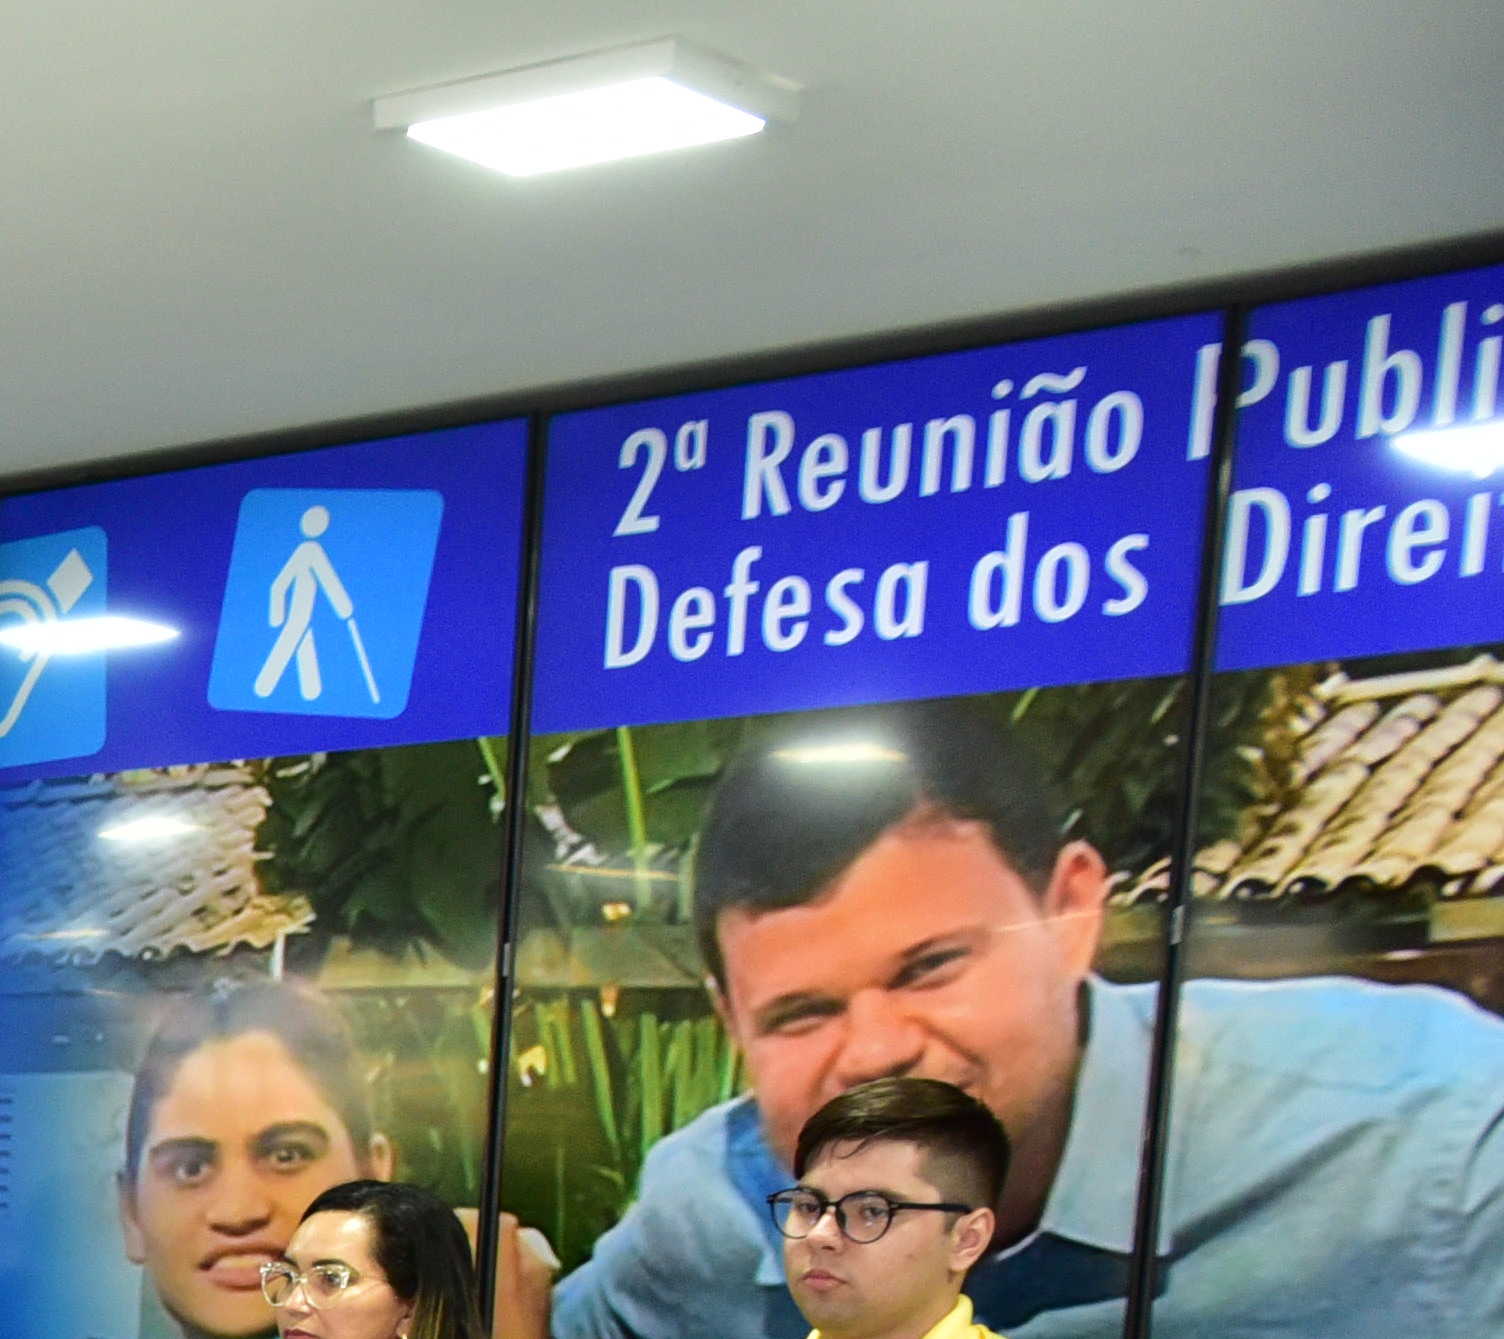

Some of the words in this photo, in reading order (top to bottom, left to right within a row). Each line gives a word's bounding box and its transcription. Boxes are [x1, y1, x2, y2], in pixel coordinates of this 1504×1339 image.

[613, 417, 710, 538] 2ª
[740, 365, 1146, 521] Reunião
[603, 545, 929, 670] Defesa
[967, 510, 1151, 631] dos
[1218, 482, 1504, 606] Direi
